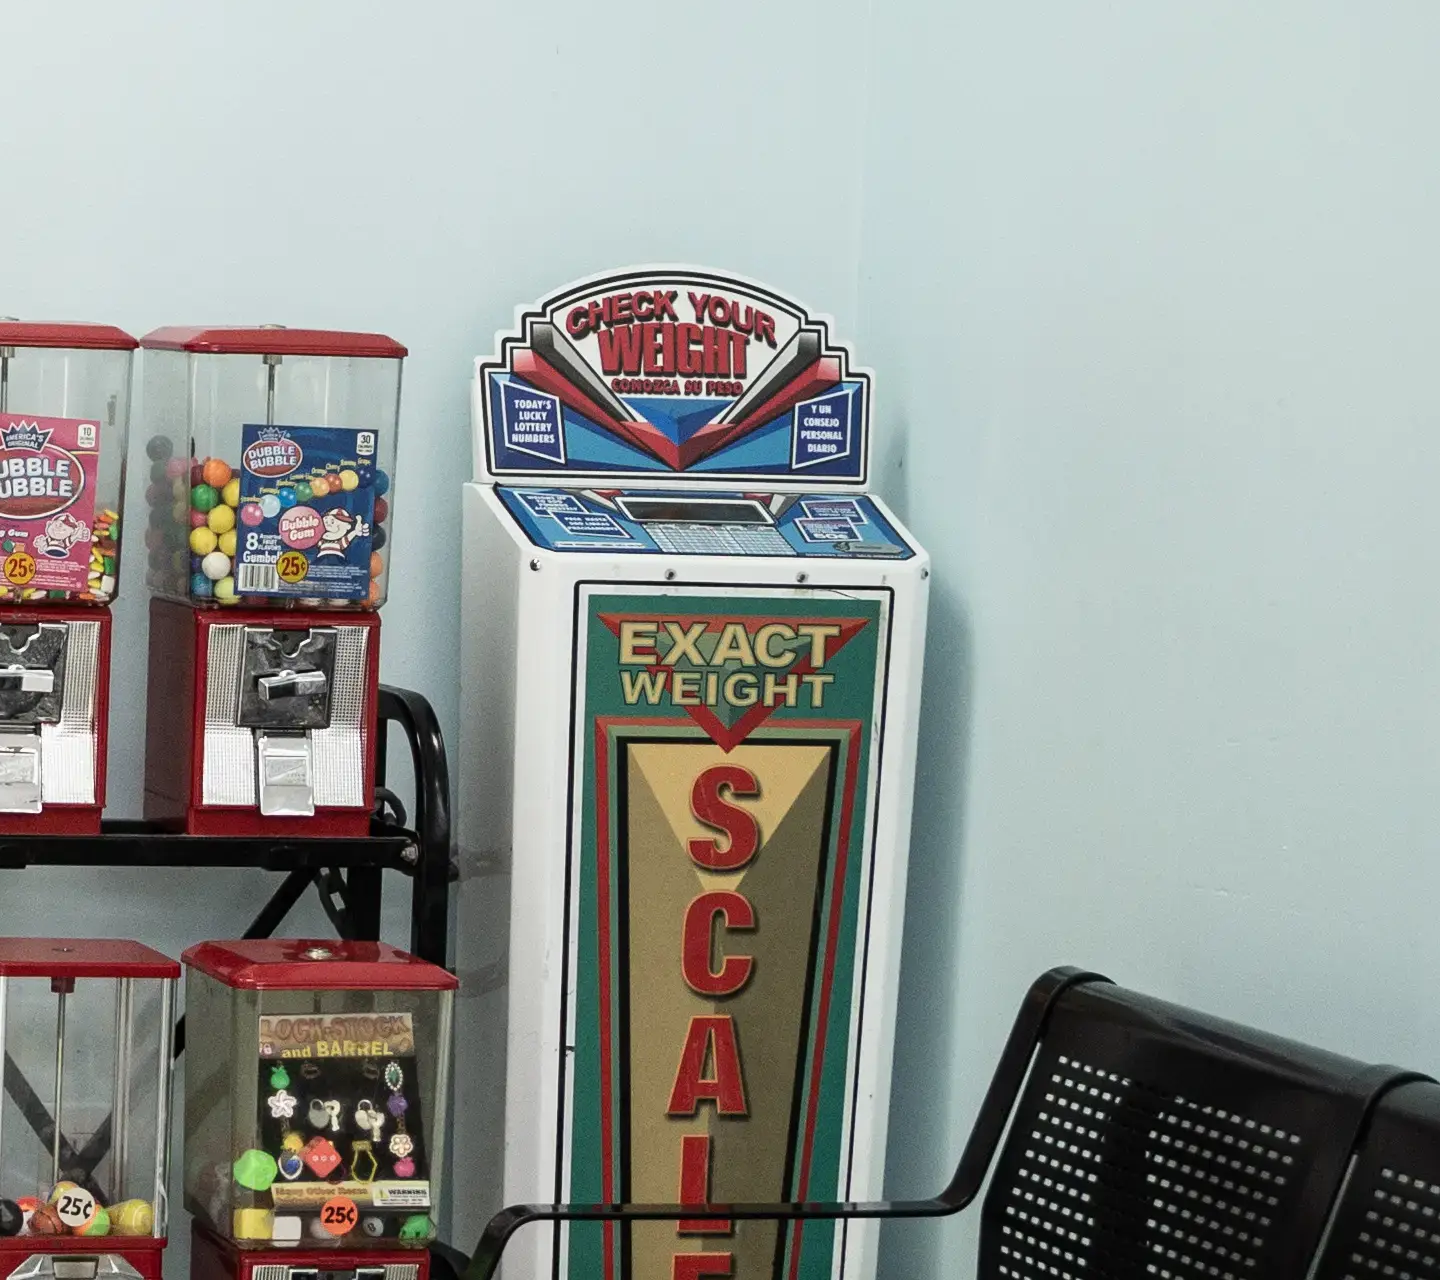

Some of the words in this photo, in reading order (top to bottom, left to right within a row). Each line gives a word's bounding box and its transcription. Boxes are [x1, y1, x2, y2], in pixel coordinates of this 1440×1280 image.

[566, 290, 679, 341] CHECK
[688, 291, 778, 350] YOUR
[597, 322, 751, 379] WEIGHT
[611, 378, 681, 396] CONOZCA
[684, 380, 703, 396] SU
[706, 380, 744, 396] PESO
[514, 399, 552, 410] TODAY'S
[811, 405, 818, 414] Y
[819, 405, 832, 414] UN
[519, 411, 548, 421] LUCKY
[803, 417, 840, 428] CONSEJO
[82, 427, 92, 437] 10
[514, 422, 552, 432] LOTTERY
[5, 433, 45, 442] AMERICA'S
[361, 434, 371, 444] 30
[511, 433, 555, 444] NUMBERS
[800, 430, 843, 440] PERSONAL
[248, 445, 297, 459] DUBBLE
[807, 443, 838, 453] DIARIO
[250, 456, 298, 470] BUBBLE
[282, 516, 320, 531] Bubble
[8, 528, 29, 538] Gum
[289, 528, 315, 541] Gum
[246, 532, 259, 551] 8
[8, 558, 35, 578] 25¢
[281, 556, 306, 577] 25¢
[618, 619, 841, 669] EXACT
[620, 669, 835, 708] WEIGHT
[282, 1046, 312, 1059] and
[316, 1040, 394, 1058] BARREL
[60, 1195, 93, 1219] 25¢
[324, 1206, 356, 1224] 25¢
